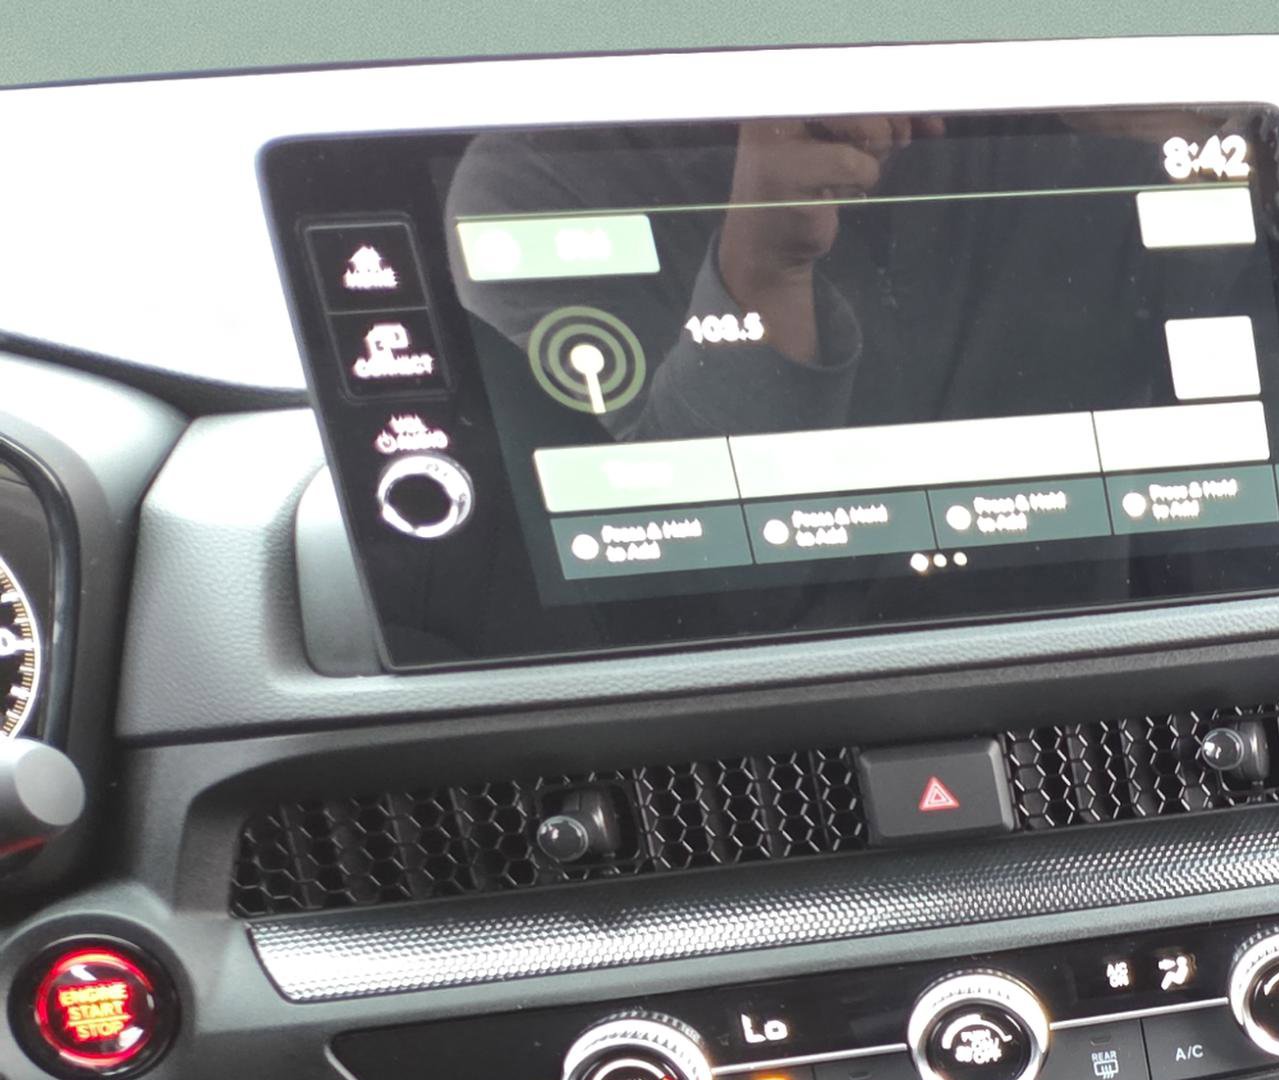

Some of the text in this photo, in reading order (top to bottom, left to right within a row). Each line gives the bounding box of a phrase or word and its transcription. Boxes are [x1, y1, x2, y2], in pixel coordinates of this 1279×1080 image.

[1163, 134, 1250, 178] 8:42
[59, 982, 128, 1007] ENGINE
[68, 1001, 124, 1020] START
[77, 1021, 124, 1039] STOP
[741, 1013, 788, 1043] Lo
[1091, 1050, 1117, 1062] REAR
[1175, 1044, 1204, 1062] A/C
